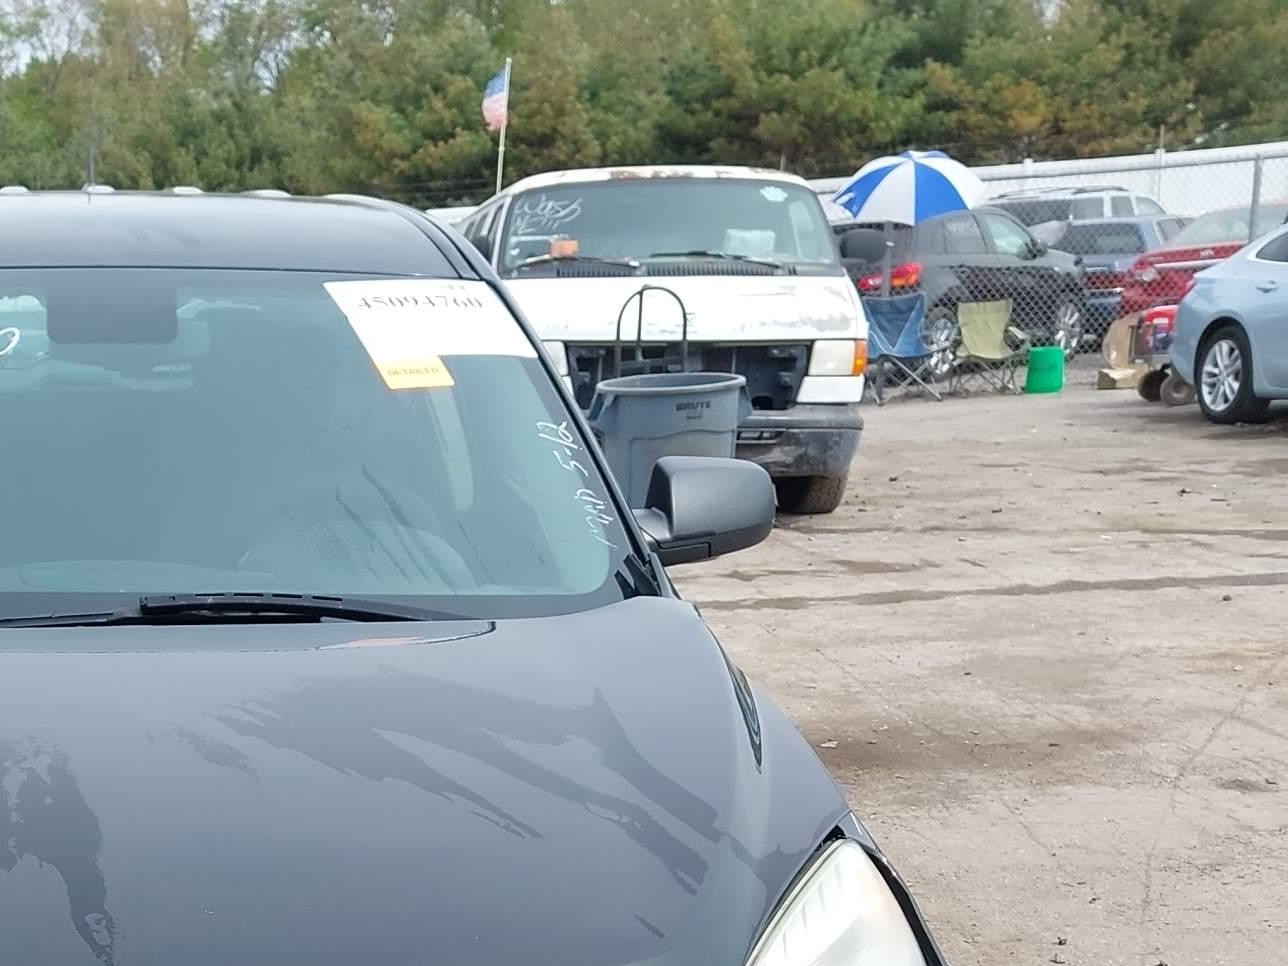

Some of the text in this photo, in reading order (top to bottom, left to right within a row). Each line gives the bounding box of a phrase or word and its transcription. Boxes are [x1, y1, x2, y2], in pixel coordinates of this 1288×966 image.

[357, 295, 483, 310] 45094760
[386, 366, 441, 377] DETAILED
[675, 401, 712, 411] BRUTE
